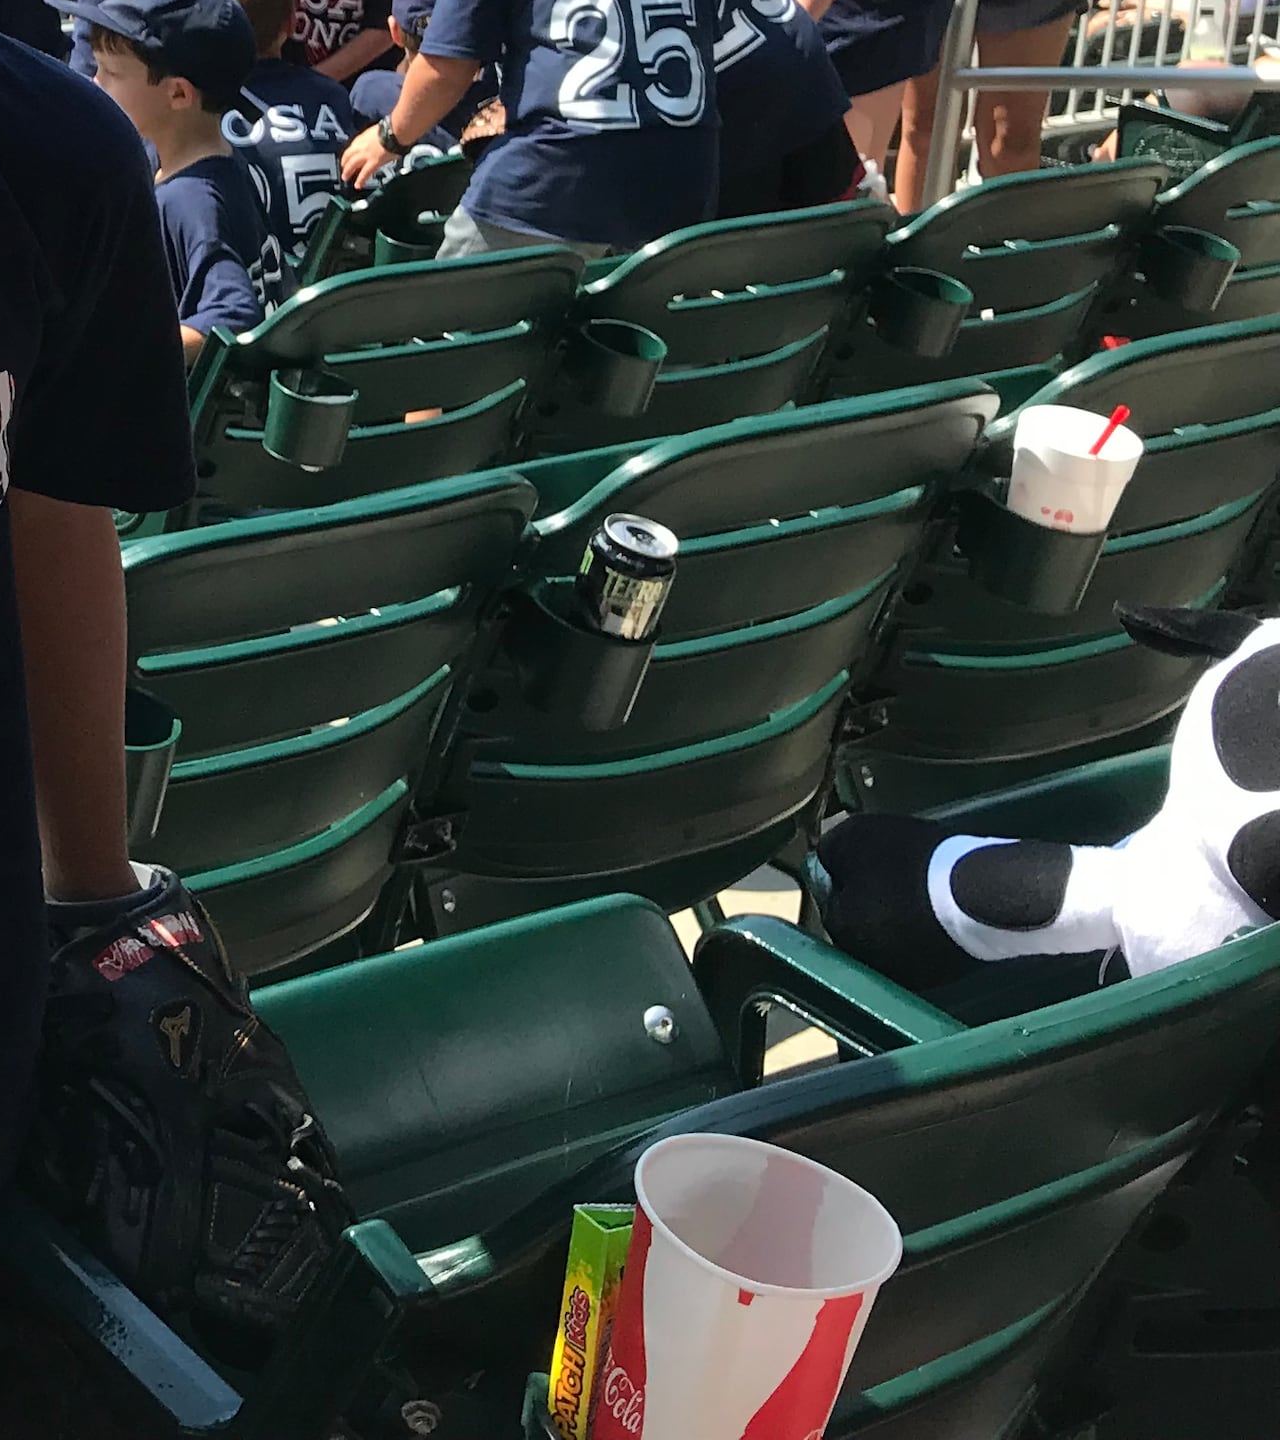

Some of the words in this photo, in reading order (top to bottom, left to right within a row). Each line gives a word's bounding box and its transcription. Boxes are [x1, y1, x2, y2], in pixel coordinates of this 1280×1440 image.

[220, 103, 350, 148] OSA
[552, 1343, 587, 1440] PATCH
[604, 1366, 643, 1434] Cola
